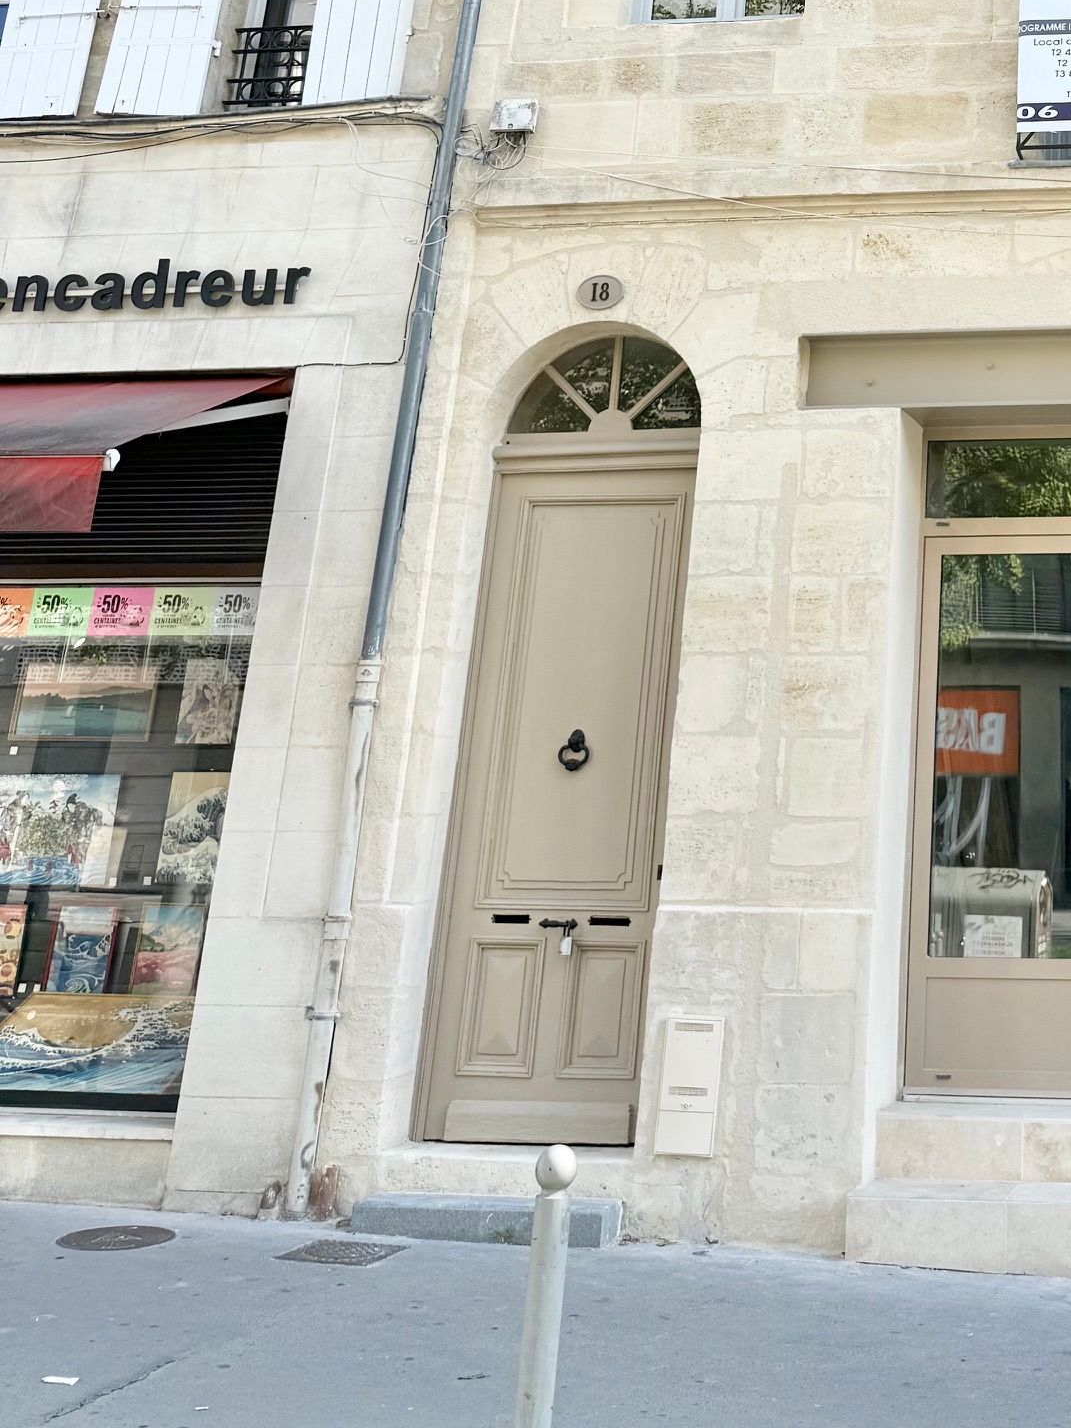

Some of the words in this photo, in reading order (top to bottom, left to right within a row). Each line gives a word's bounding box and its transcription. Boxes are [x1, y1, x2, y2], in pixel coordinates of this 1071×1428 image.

[1019, 22, 1066, 32] OGRAMME
[1033, 38, 1063, 46] Local
[1051, 48, 1061, 56] T2
[1057, 59, 1068, 67] T2
[1055, 69, 1066, 78] T3
[1017, 103, 1059, 118] 06
[0, 258, 312, 311] ncadreur
[590, 282, 610, 302] 18
[96, 594, 129, 613] -50%
[158, 594, 190, 613] -50%
[219, 594, 251, 613] -50%
